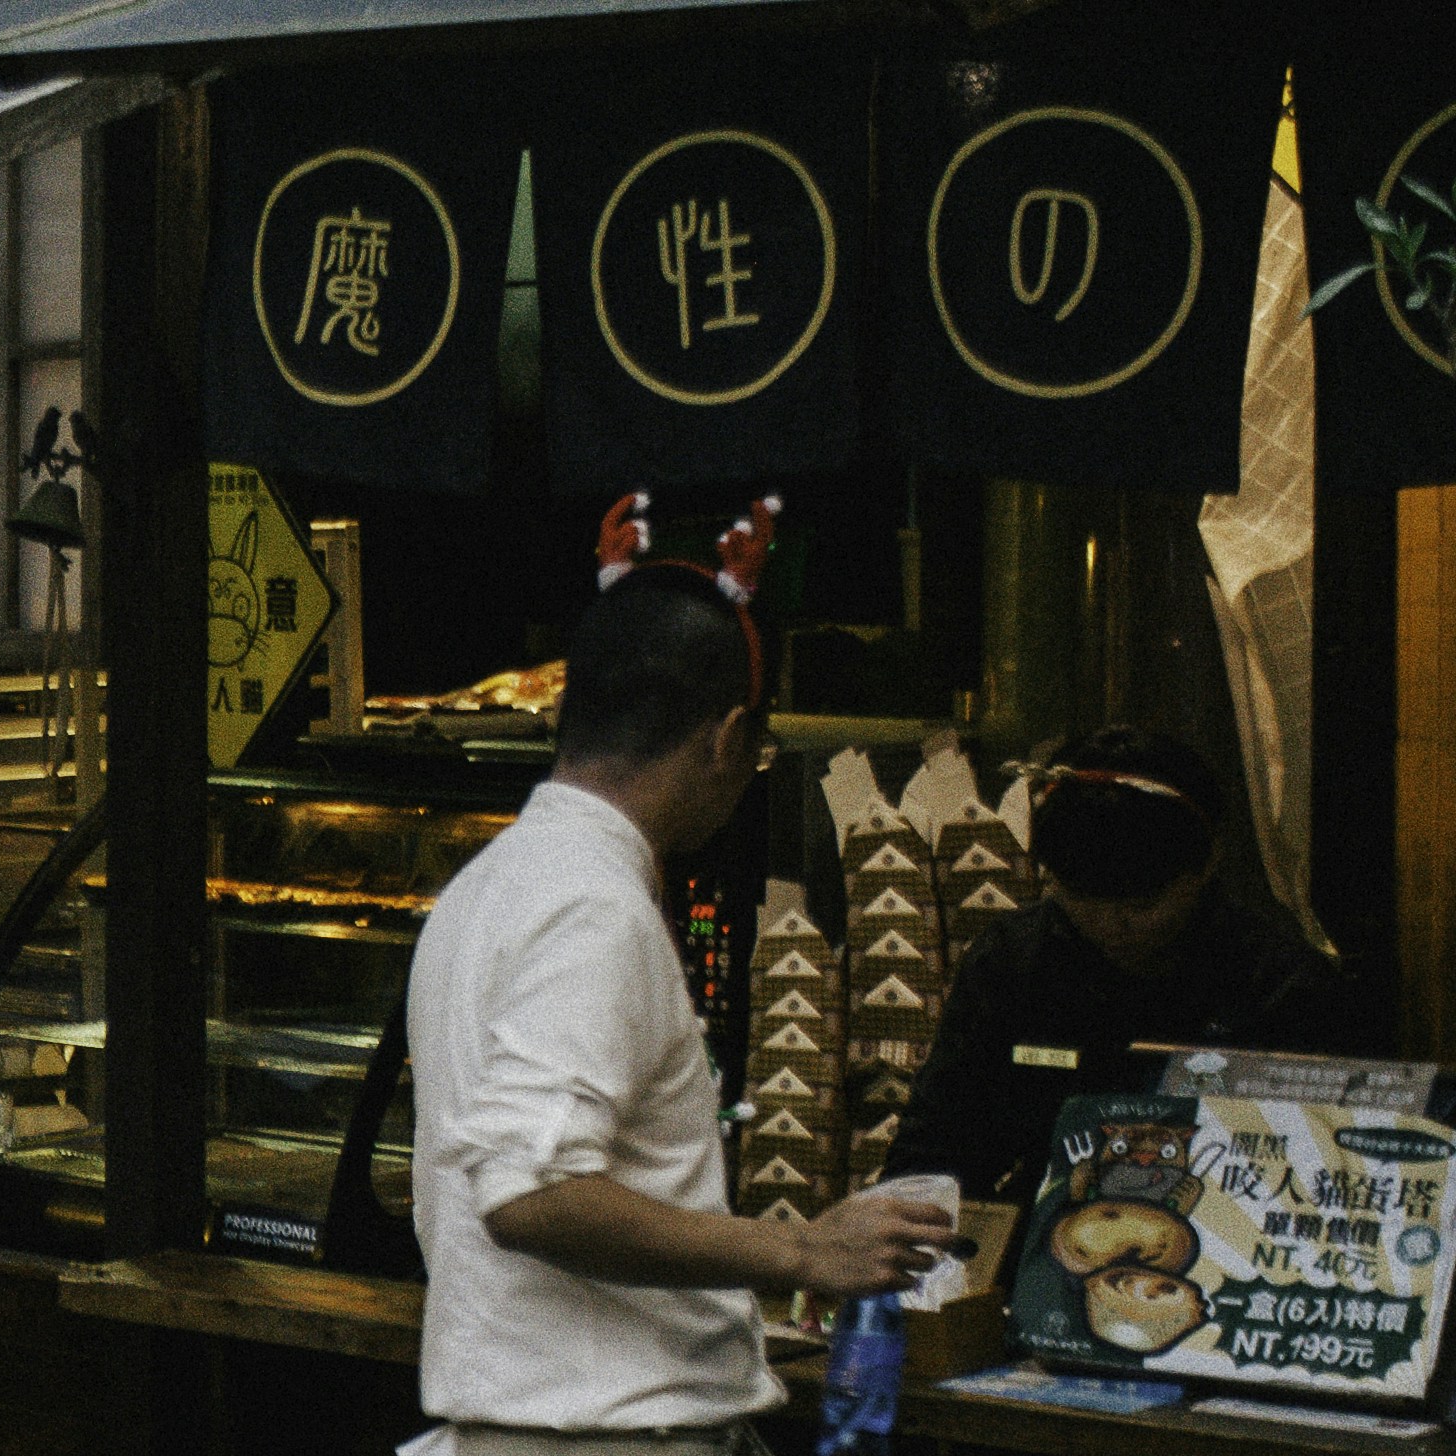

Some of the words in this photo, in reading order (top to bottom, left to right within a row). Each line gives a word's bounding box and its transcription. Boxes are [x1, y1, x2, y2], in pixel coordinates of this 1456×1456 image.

[293, 206, 392, 357] 魔
[657, 199, 760, 350] 性
[1008, 188, 1100, 322] の
[265, 577, 298, 633] 意
[224, 1213, 317, 1241] PROFESSIONAL
